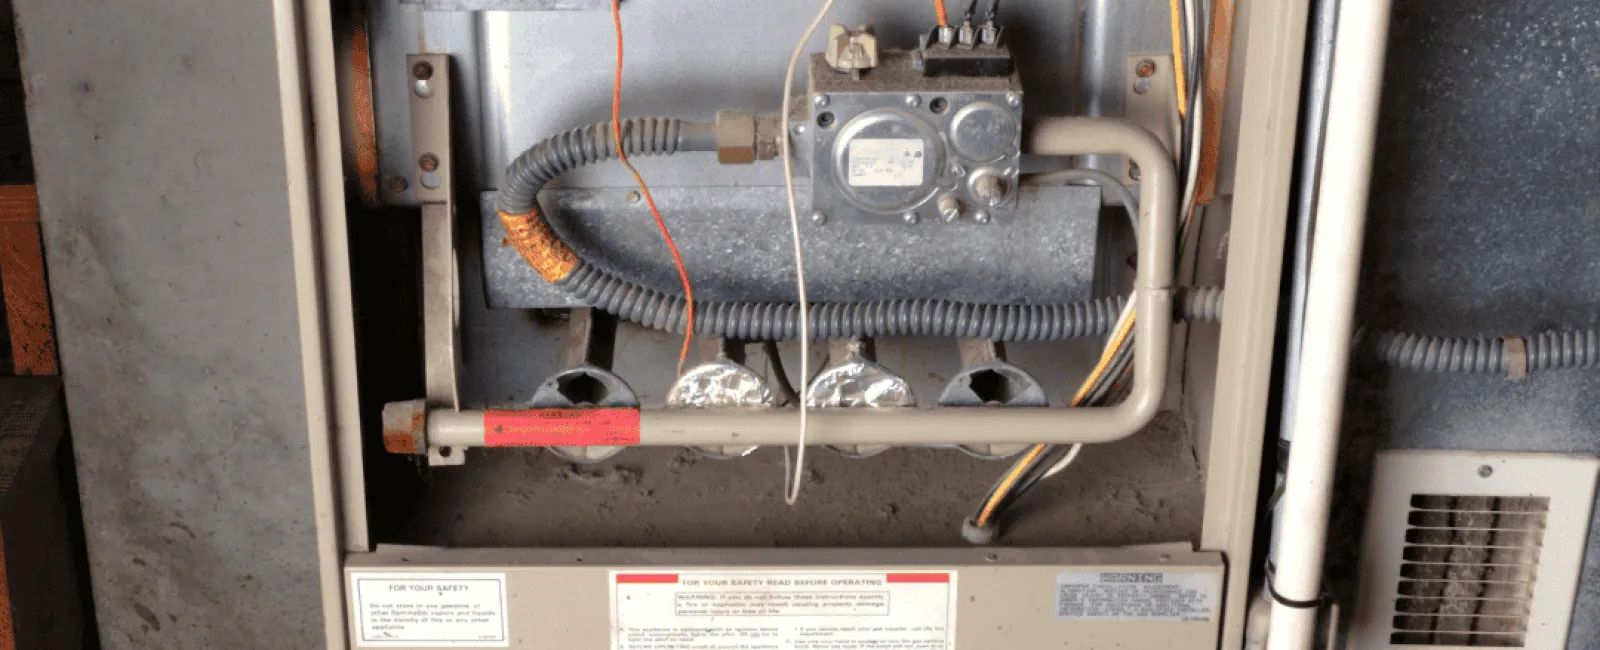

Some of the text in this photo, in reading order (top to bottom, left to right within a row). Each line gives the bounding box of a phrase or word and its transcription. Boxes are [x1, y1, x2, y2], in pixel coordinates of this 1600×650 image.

[388, 584, 469, 592] FOR YOUR SAFETY
